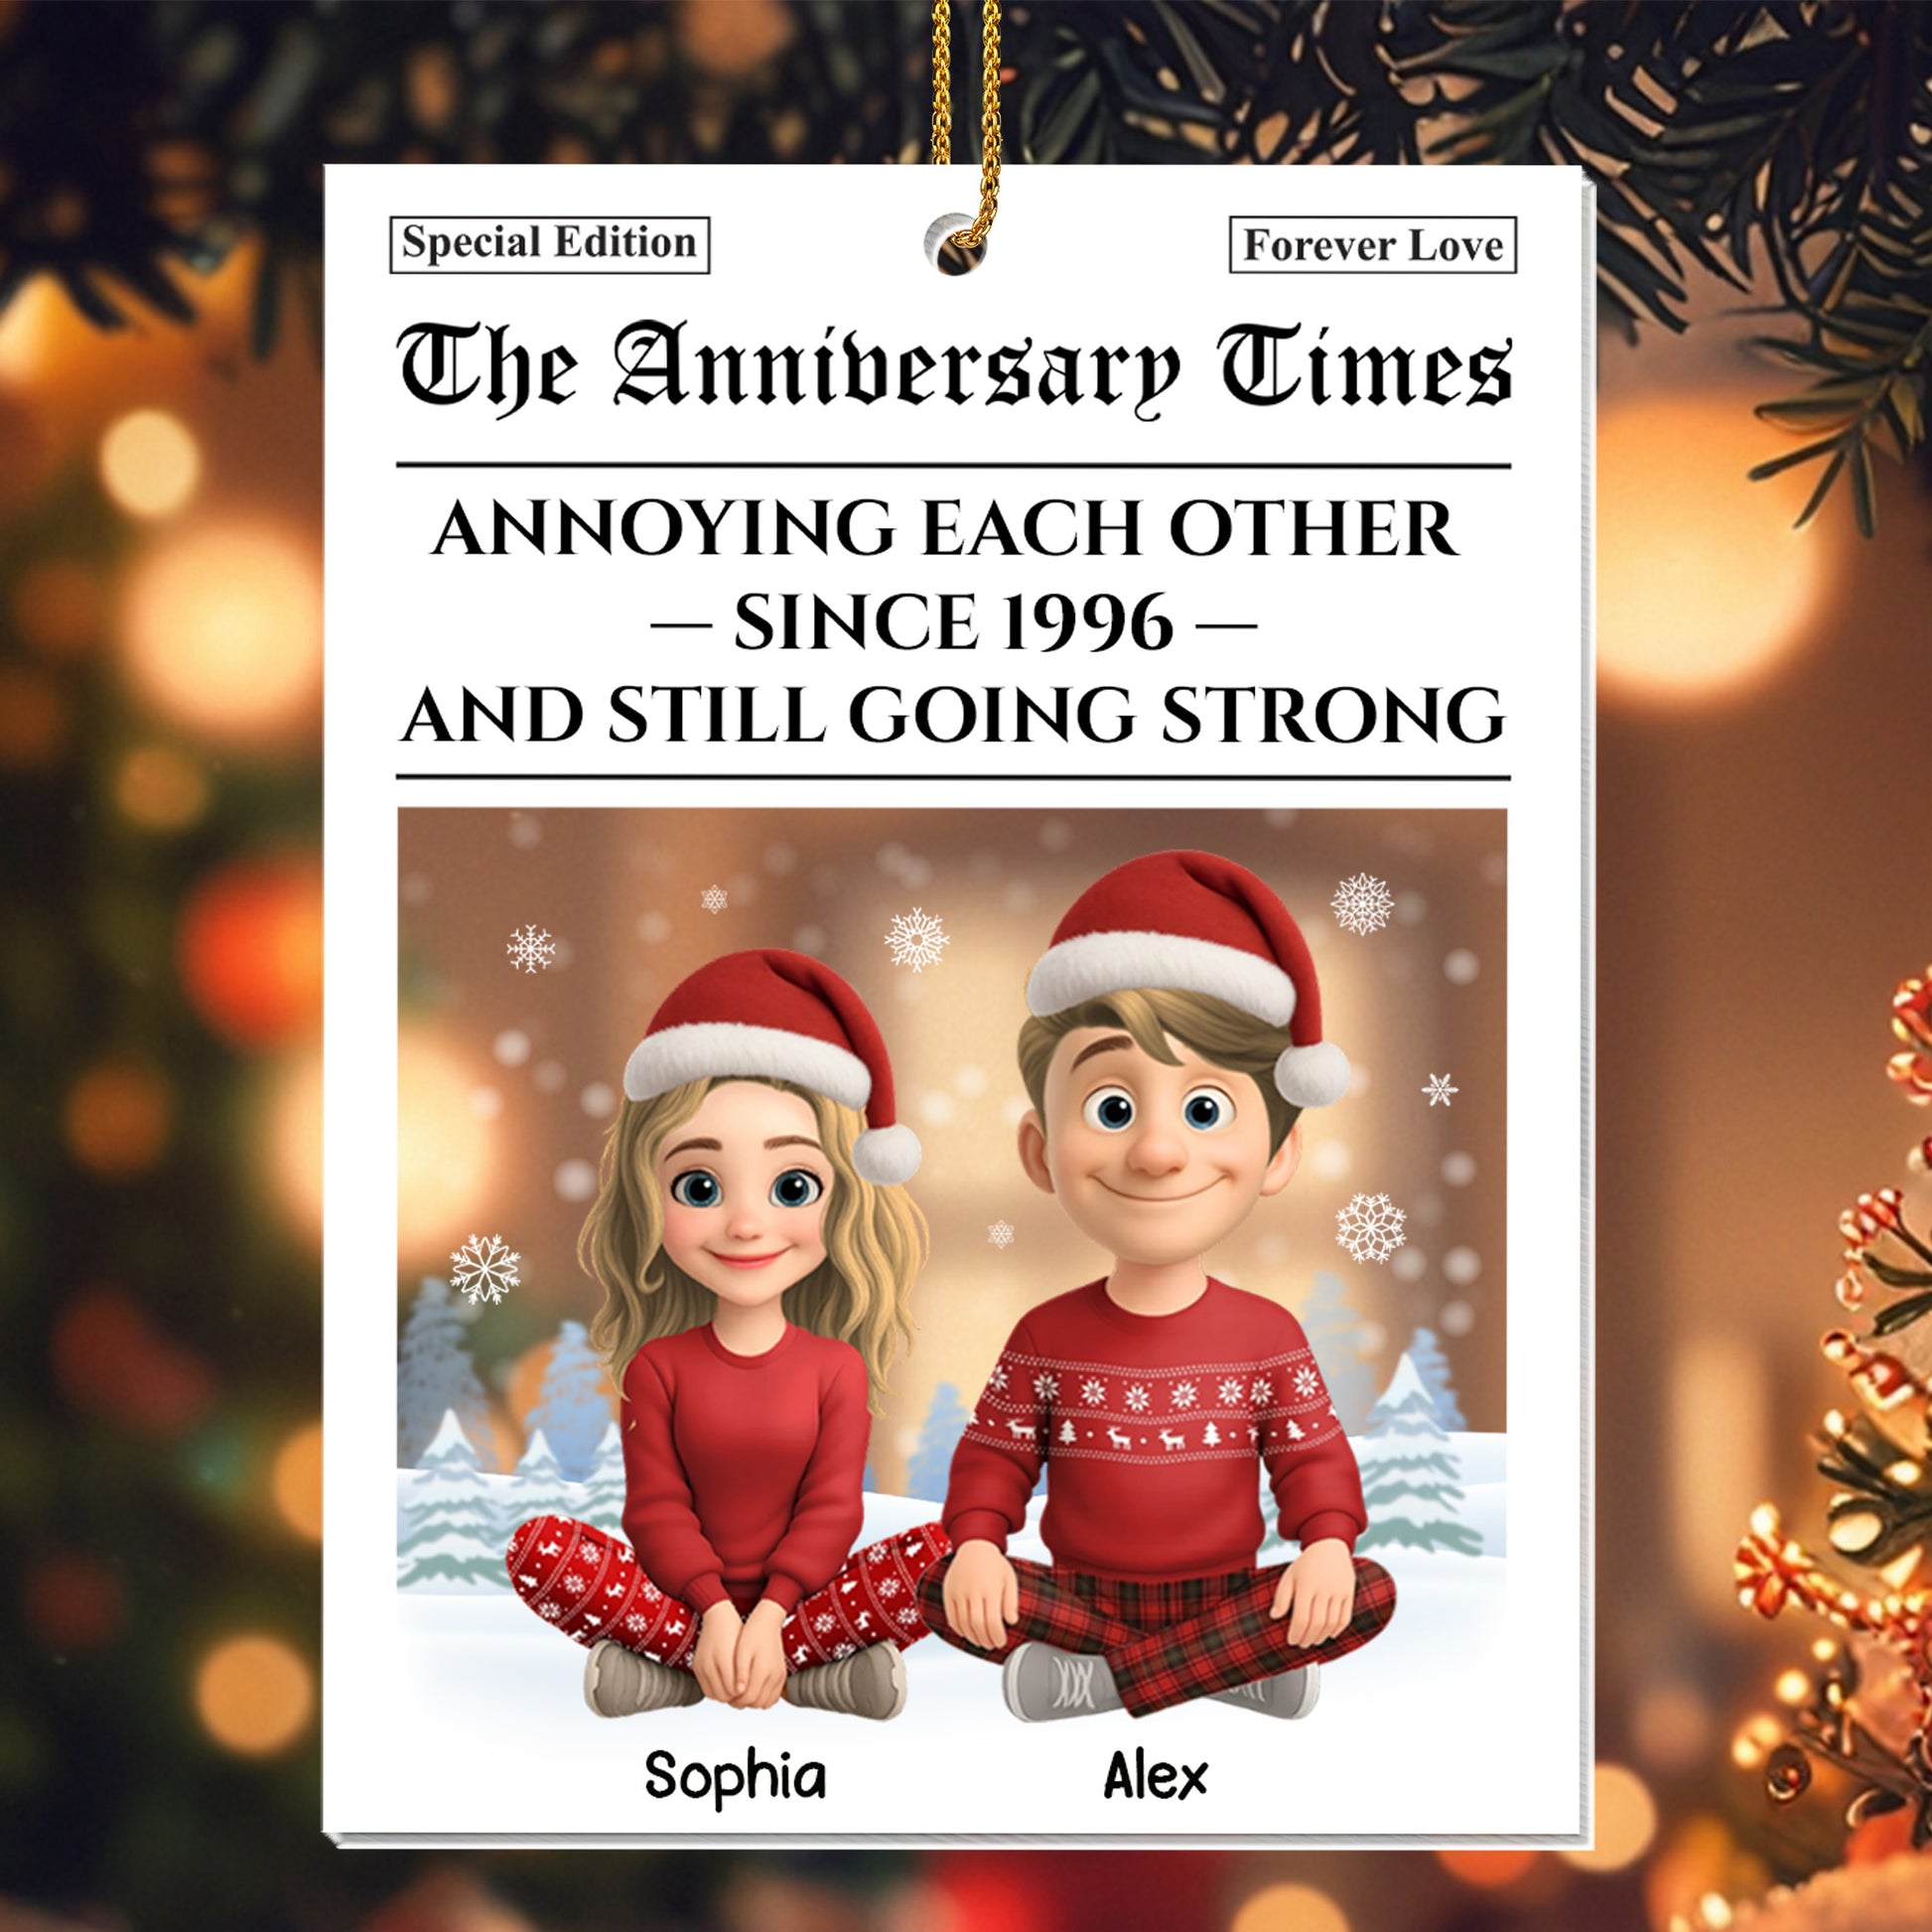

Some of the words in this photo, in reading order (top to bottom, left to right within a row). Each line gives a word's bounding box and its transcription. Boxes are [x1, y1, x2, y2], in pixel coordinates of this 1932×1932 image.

[403, 223, 541, 267] Special
[555, 223, 697, 258] Edition
[1244, 228, 1397, 261] Forever
[1409, 228, 1504, 261] Love
[395, 321, 579, 422] The
[613, 319, 1181, 423] Anniversary
[1216, 322, 1513, 407] Times
[429, 497, 896, 557] ANNOYING
[922, 498, 1142, 557] EACH
[1170, 498, 1460, 557] OTHER
[735, 593, 979, 651] SINCE
[1004, 591, 1173, 653] 1996
[398, 685, 584, 743] AND
[609, 685, 827, 744] STILL
[849, 685, 1136, 744] GOING
[1163, 686, 1505, 745] STRONG
[645, 1745, 826, 1814] Sophia
[1103, 1745, 1209, 1801] Alex
